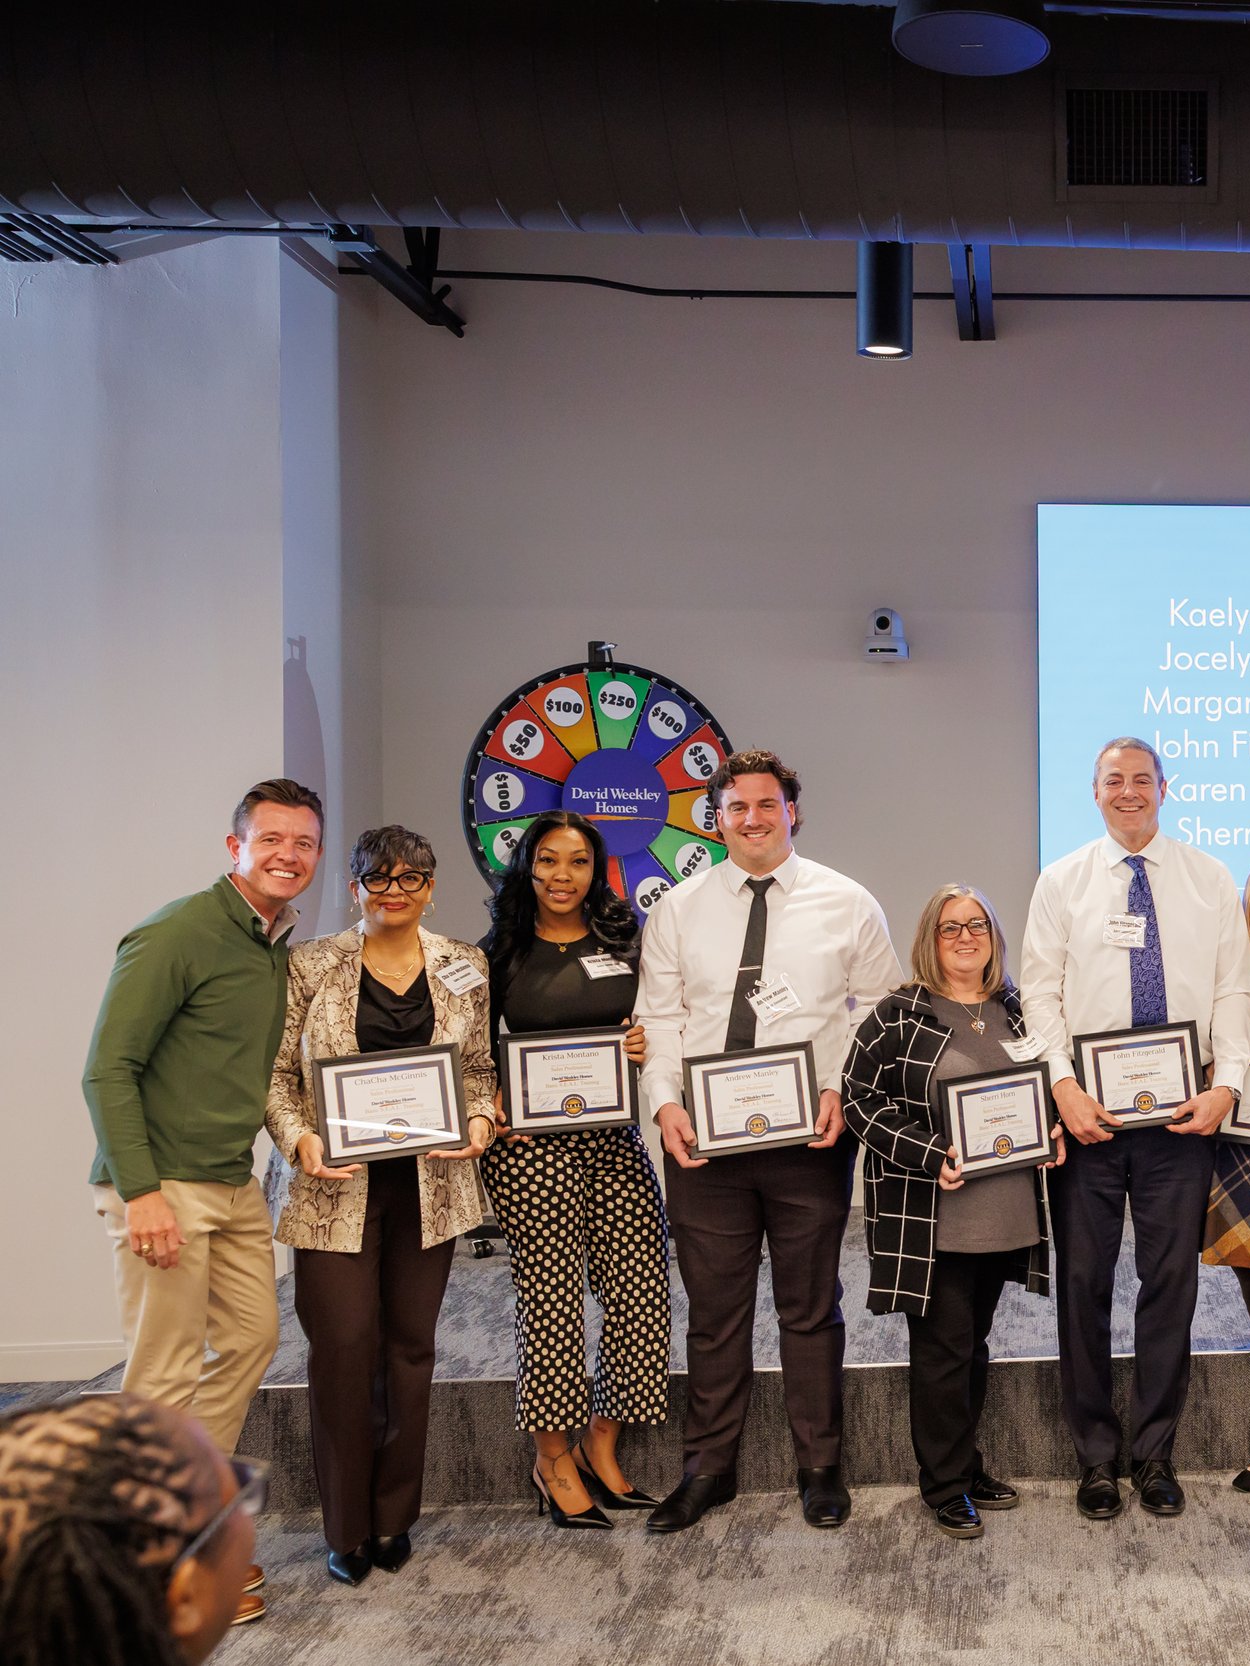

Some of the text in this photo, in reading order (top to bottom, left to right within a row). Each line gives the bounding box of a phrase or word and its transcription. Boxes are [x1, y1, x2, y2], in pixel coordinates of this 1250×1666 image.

[546, 698, 583, 714] $100
[600, 691, 635, 709] $250
[651, 706, 683, 734] $100
[509, 724, 537, 756] $50
[1155, 729, 1219, 758] John
[688, 745, 713, 777] $50
[495, 774, 511, 811] $100
[571, 787, 661, 803] David Weekley
[1166, 774, 1246, 802] Karen
[595, 802, 638, 814] Homes
[681, 845, 707, 878] $250
[542, 1050, 599, 1061] Krista Montano
[1113, 1051, 1130, 1060] John
[354, 1072, 427, 1086] ChaCha McGinnis
[724, 1074, 750, 1082] Andrew
